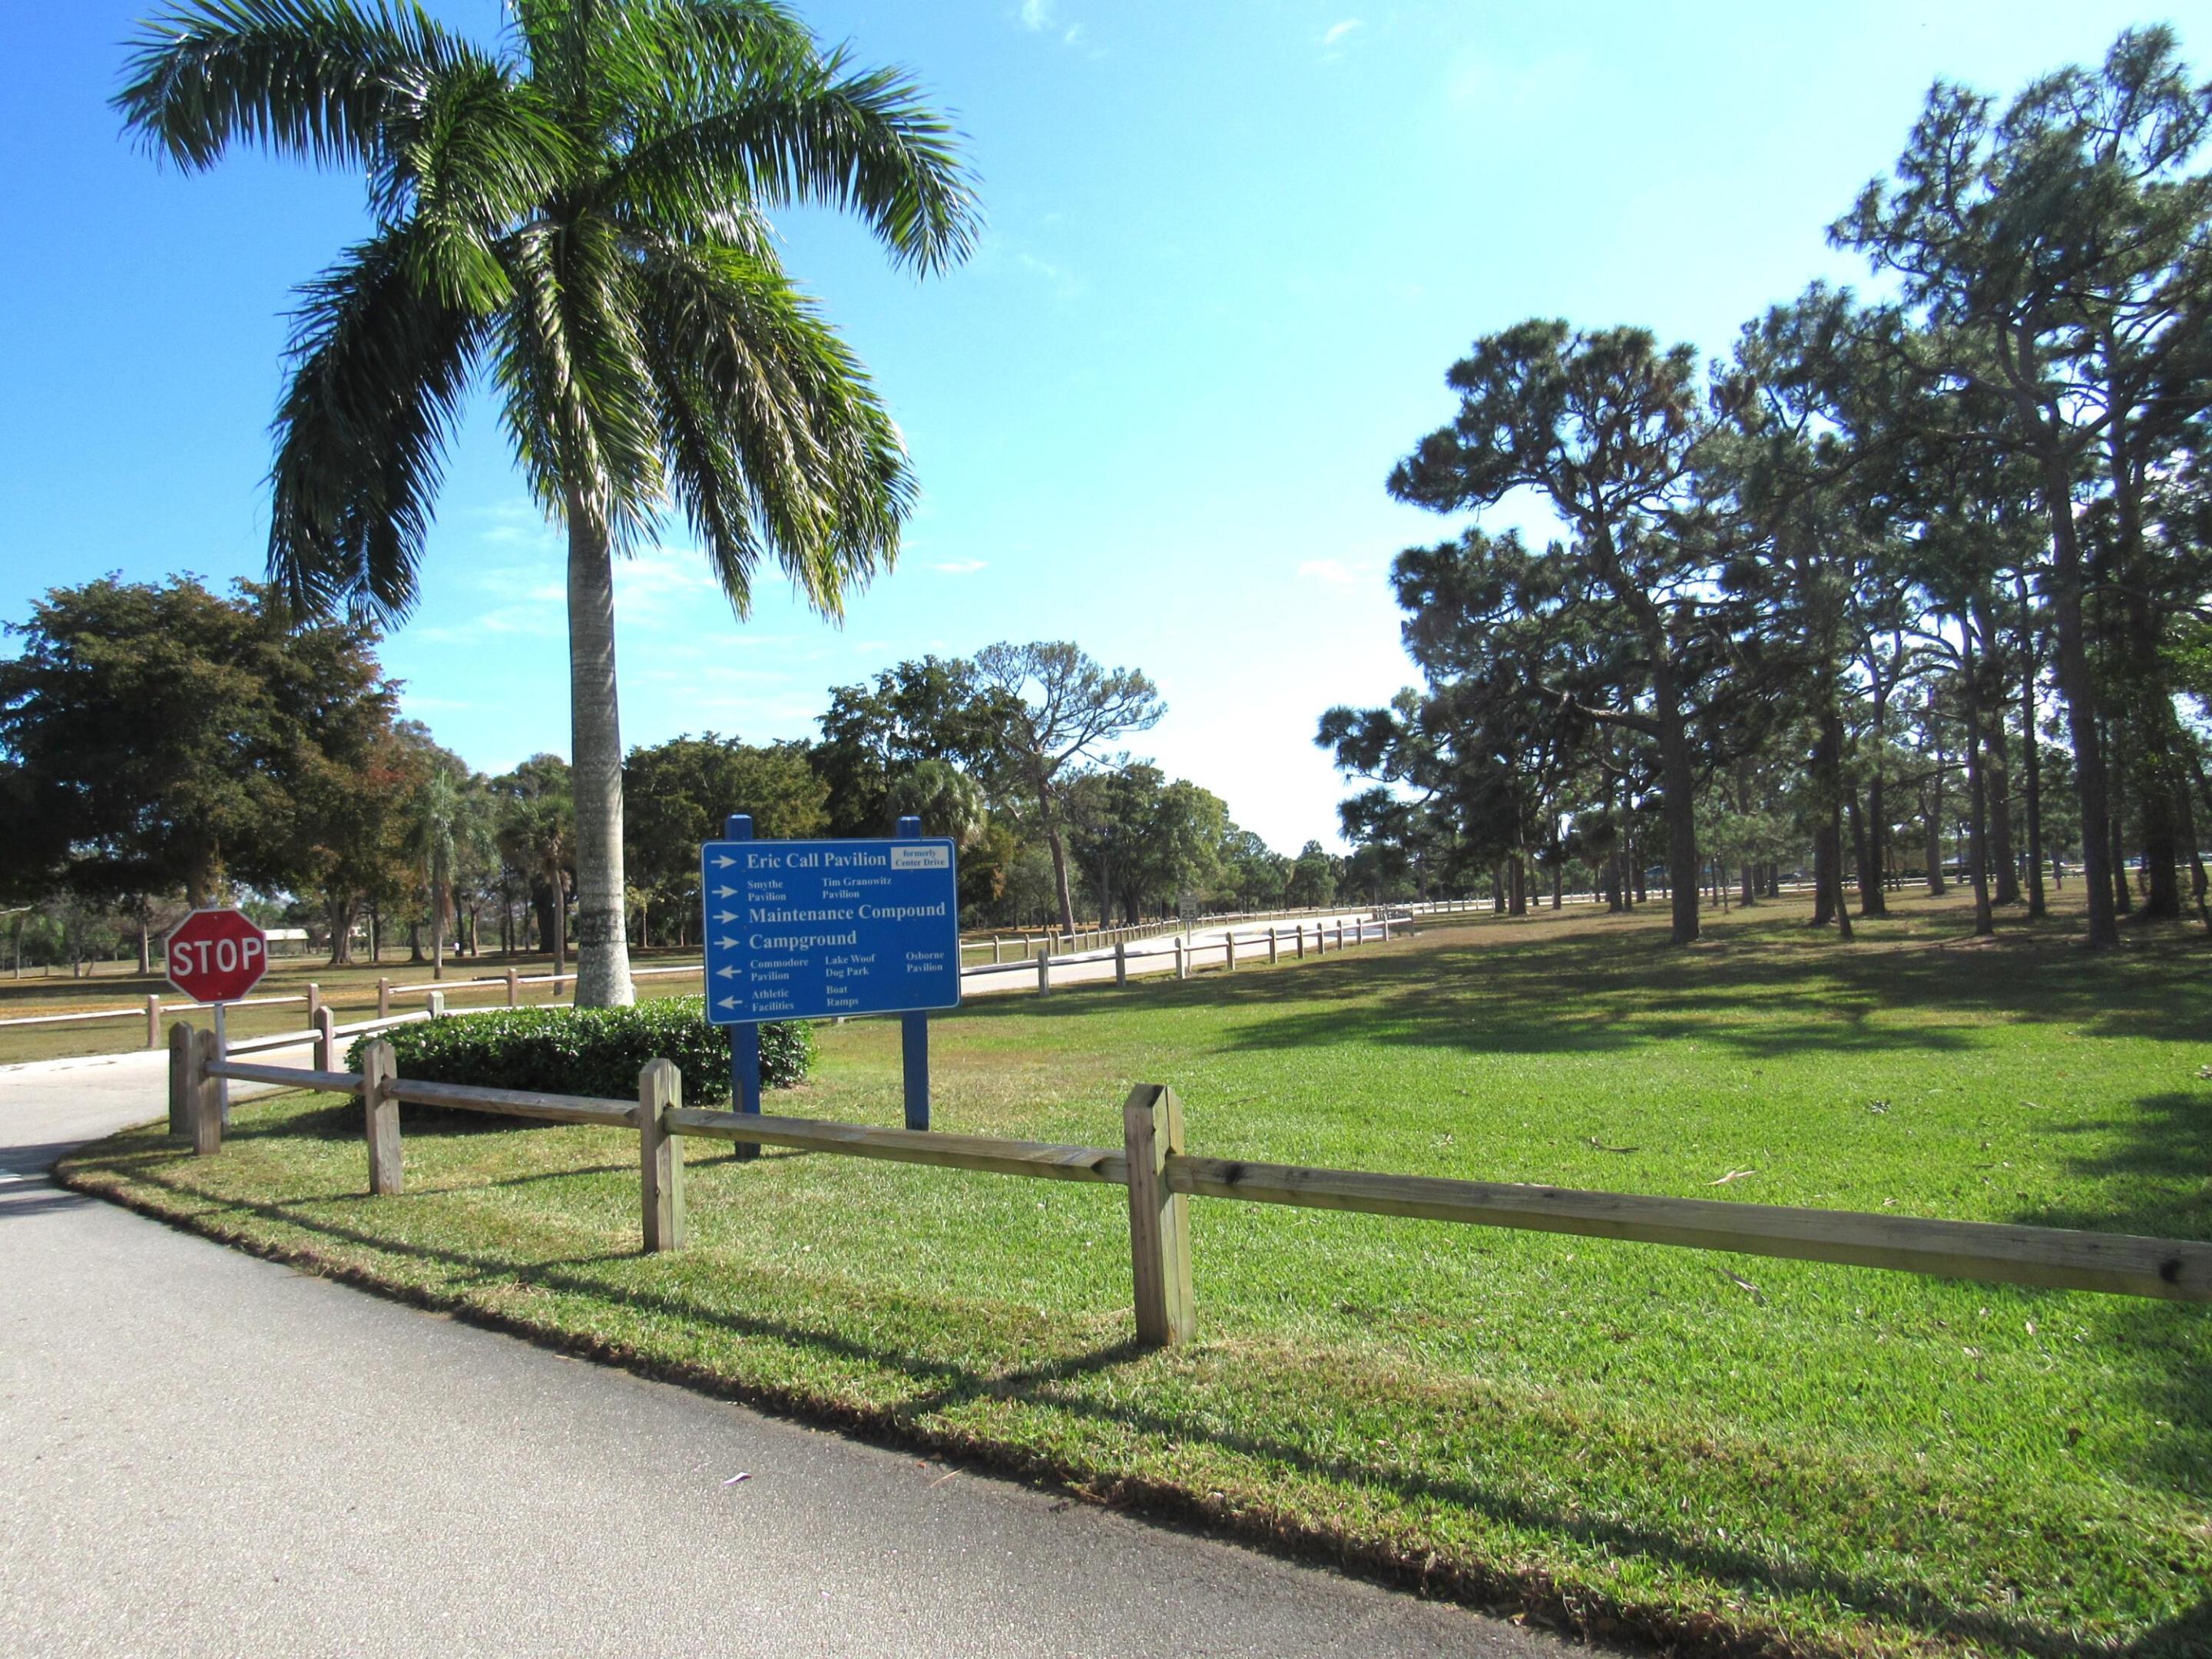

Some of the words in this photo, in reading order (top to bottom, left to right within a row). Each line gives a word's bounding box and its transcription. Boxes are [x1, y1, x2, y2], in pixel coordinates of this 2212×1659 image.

[903, 849, 936, 858] formerly
[747, 853, 781, 869] Eric
[786, 853, 819, 868] Call
[824, 852, 886, 866] Pavilion
[747, 879, 783, 891] Smythe
[822, 878, 840, 886] Tim
[843, 876, 892, 886] Granowitz
[748, 892, 786, 902] Pavilion
[823, 889, 859, 899] Pavilion
[750, 907, 854, 923] Maintenance
[859, 902, 945, 921] Compound
[1181, 909, 1196, 919] 25
[750, 930, 856, 951] Campground
[173, 936, 262, 976] STOP
[825, 955, 848, 965] Lake
[851, 953, 876, 963] Woof
[906, 952, 944, 960] Osborne
[750, 959, 809, 969] Commodore
[906, 963, 943, 972] Pavilion
[751, 972, 790, 982] Pavilion
[826, 968, 844, 979] Dog
[847, 966, 869, 976] Park
[752, 988, 790, 998] Athletic
[826, 985, 847, 994] Boat
[753, 1001, 794, 1012] Facilities
[827, 998, 859, 1008] Ramps
